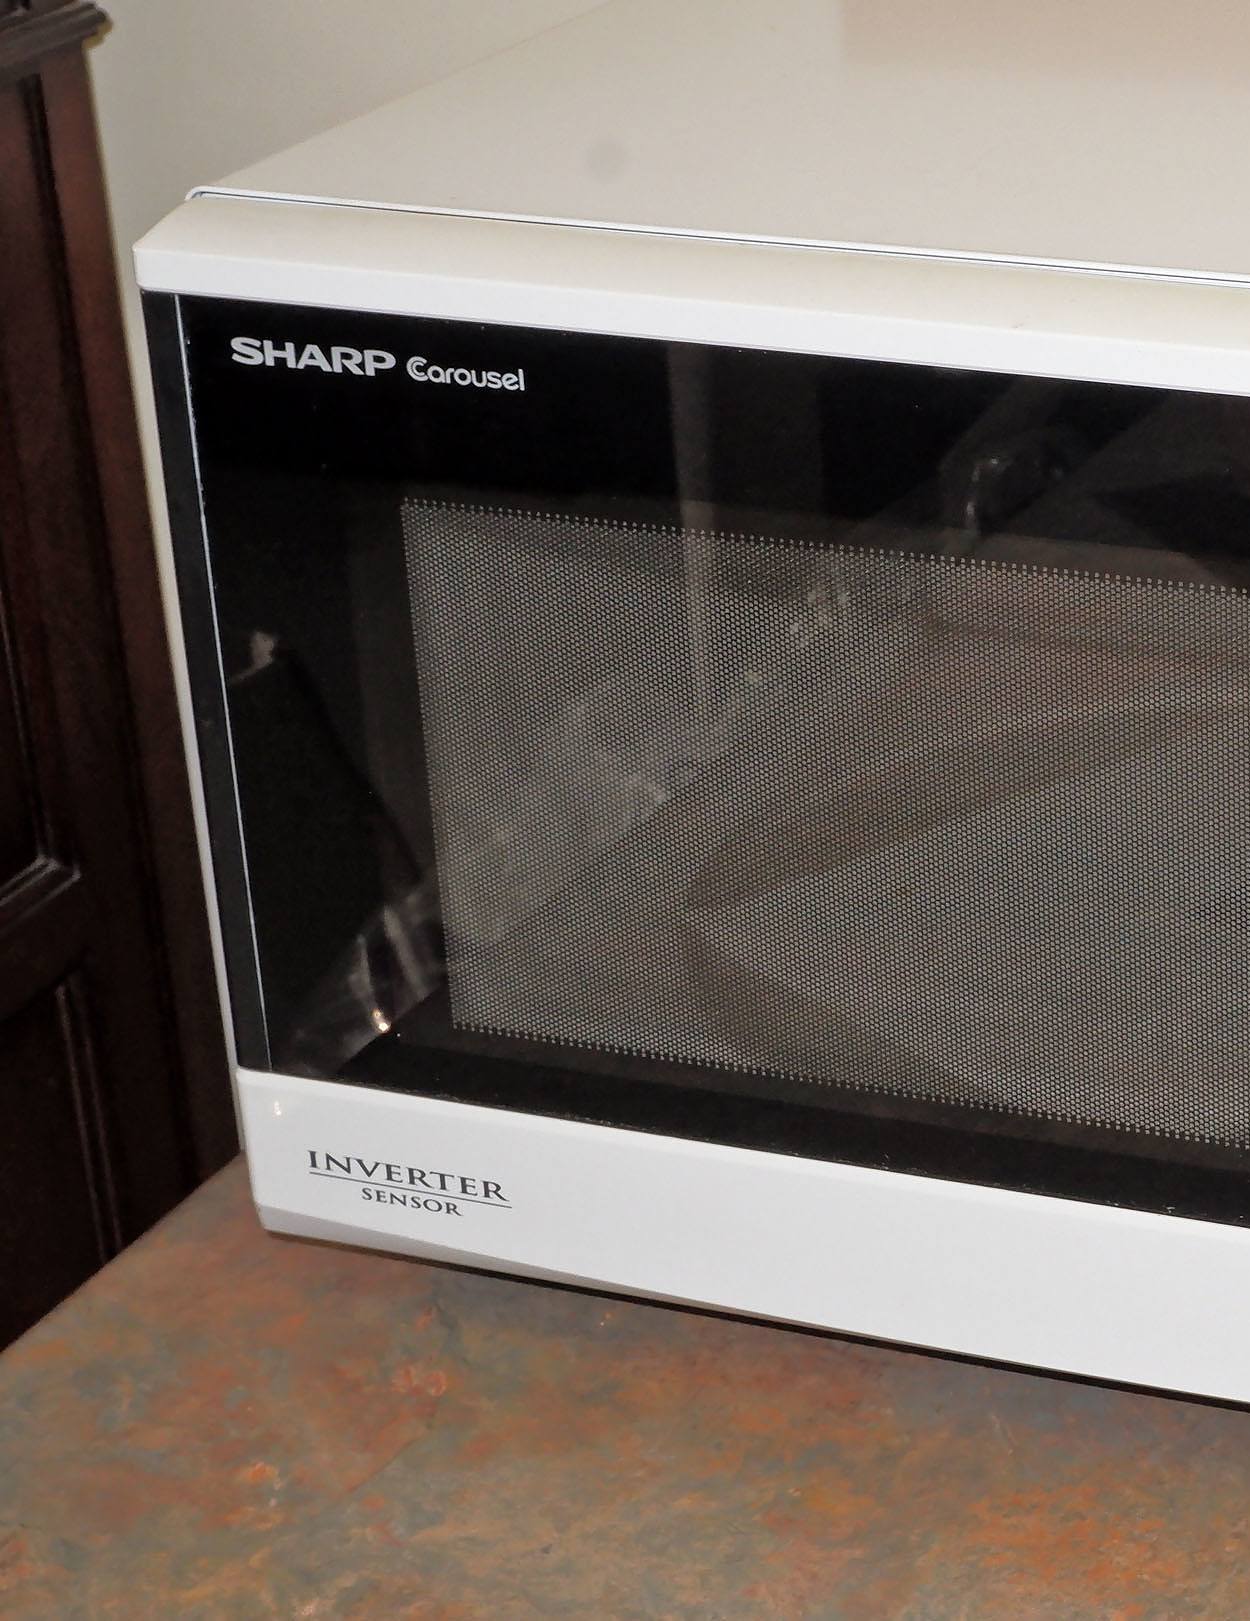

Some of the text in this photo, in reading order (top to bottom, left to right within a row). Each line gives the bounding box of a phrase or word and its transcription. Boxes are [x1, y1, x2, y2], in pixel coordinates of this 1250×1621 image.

[230, 337, 396, 376] SHARP
[406, 356, 525, 391] Carousel
[308, 1150, 510, 1201] INVERTER
[362, 1188, 463, 1216] SENSOR
